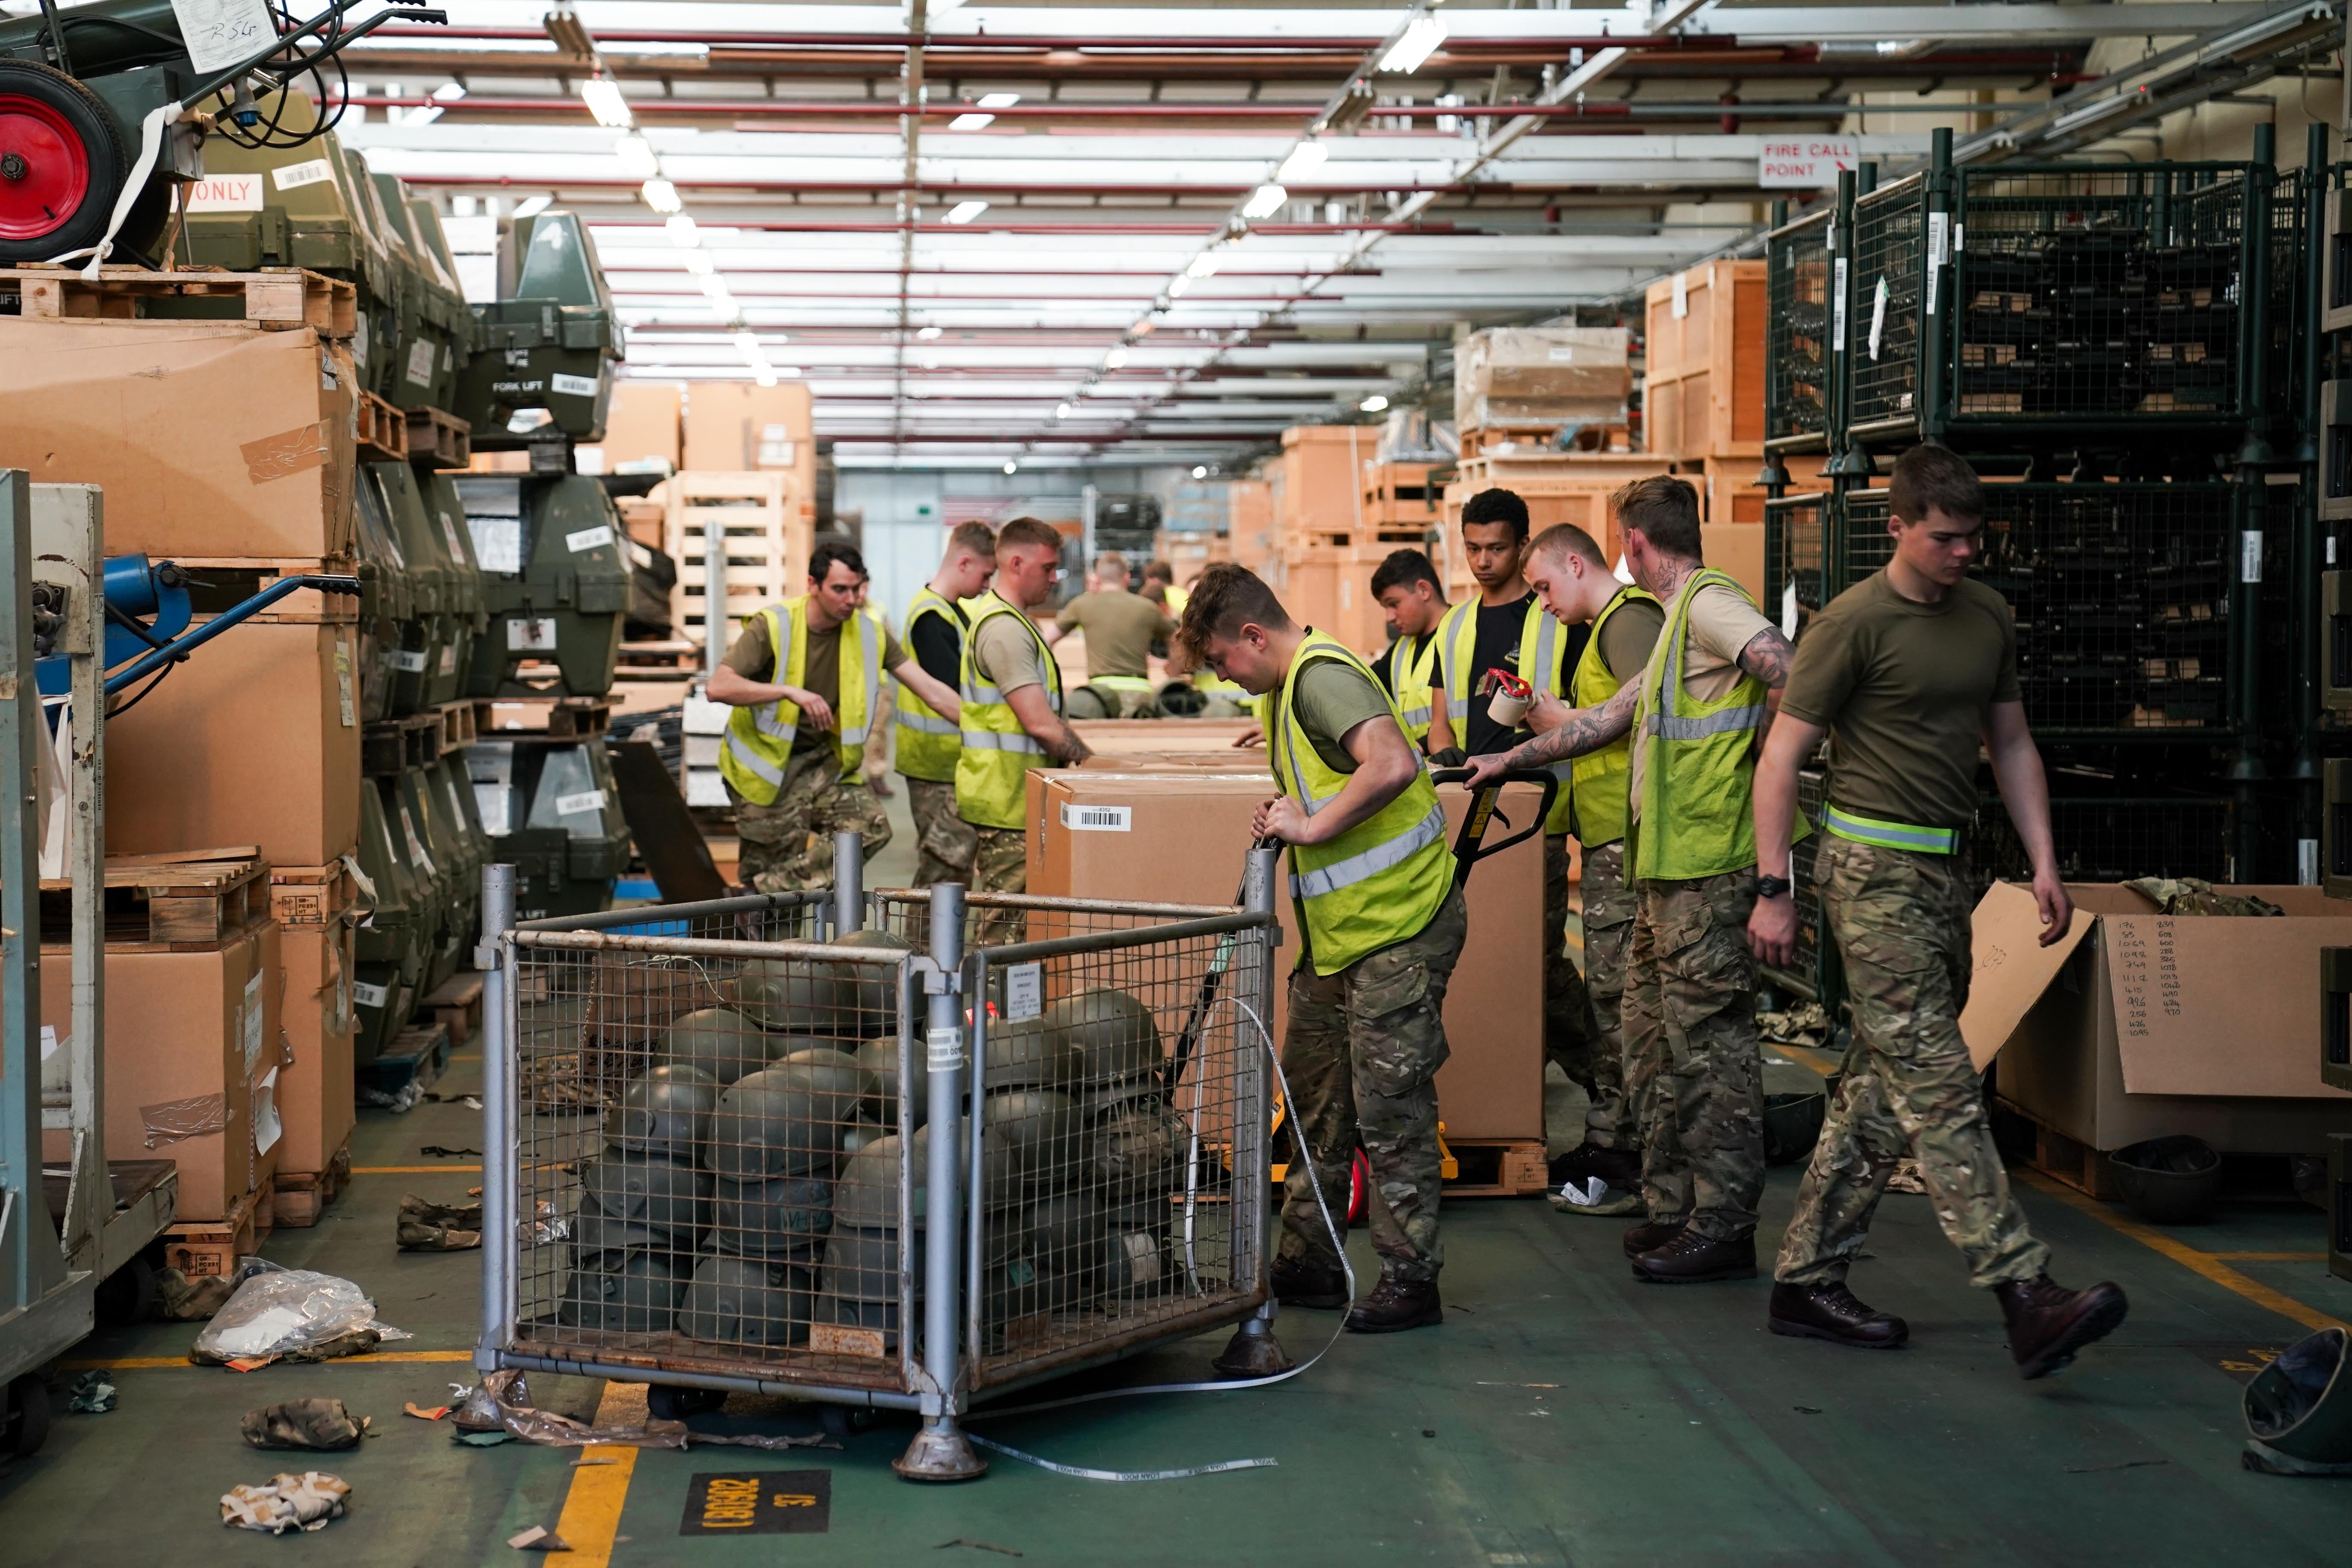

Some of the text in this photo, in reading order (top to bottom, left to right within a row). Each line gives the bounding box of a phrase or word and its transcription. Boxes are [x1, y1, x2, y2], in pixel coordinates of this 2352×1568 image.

[1765, 144, 1852, 157] FIRE CALL
[1765, 163, 1815, 177] POINT
[196, 182, 250, 200] ONLY
[0, 294, 21, 304] IFT
[493, 381, 543, 392] FORK LIFT
[526, 909, 546, 919] LIFT
[1262, 1028, 1279, 1066] LOAN POOLS
[1287, 1095, 1296, 1118] POOLS
[1309, 1163, 1324, 1203] LOAN POOLS
[1332, 1230, 1351, 1270] LOAN POOLS
[1056, 1465, 1087, 1476] LOAN POOLS
[773, 1494, 817, 1508] 37
